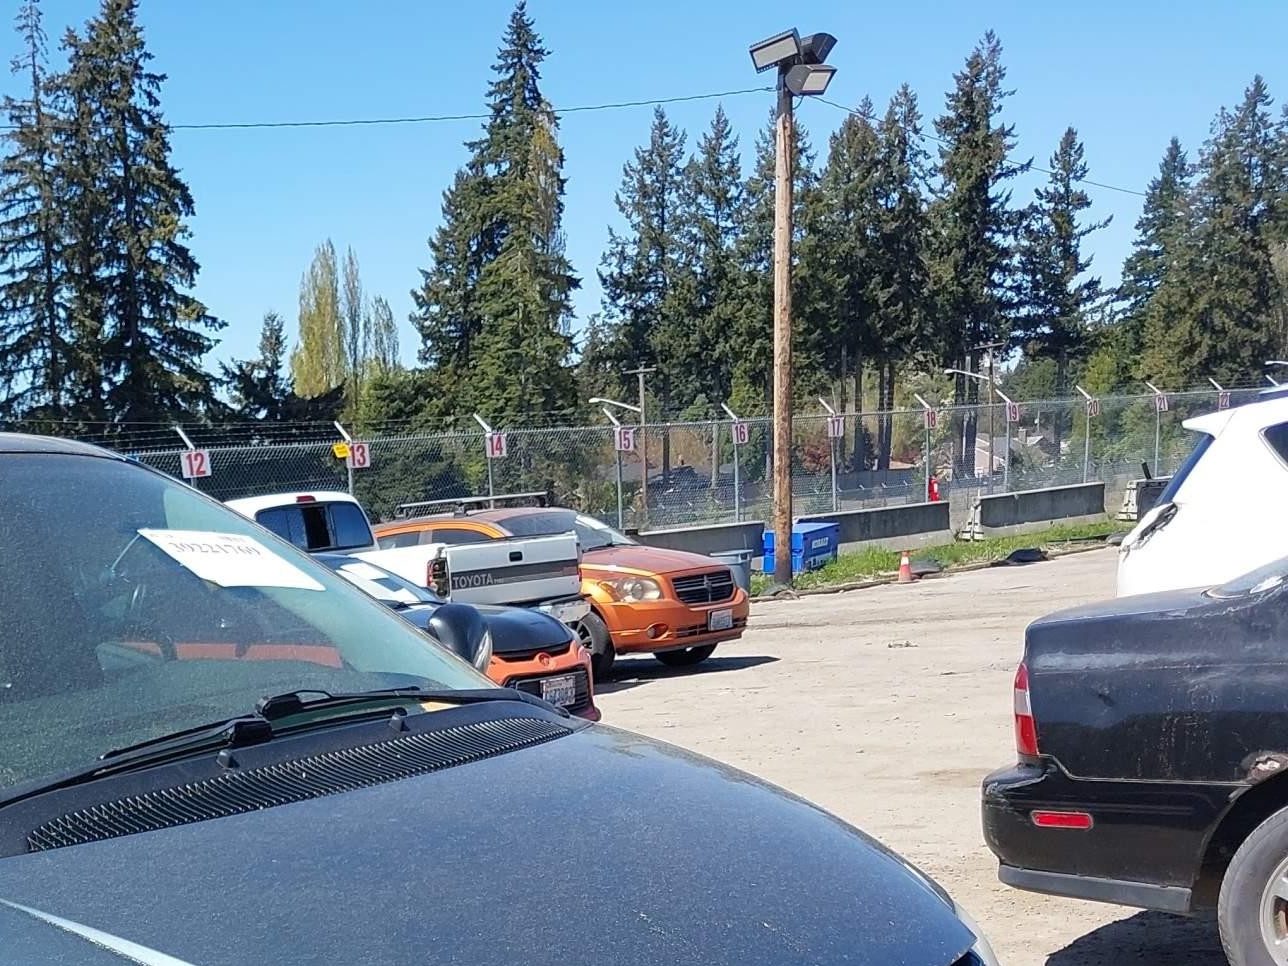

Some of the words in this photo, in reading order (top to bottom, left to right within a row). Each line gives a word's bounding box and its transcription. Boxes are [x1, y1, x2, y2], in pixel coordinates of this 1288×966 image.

[1007, 403, 1018, 421] 19
[1088, 400, 1098, 416] 20
[1158, 396, 1168, 411] 21
[831, 418, 841, 436] 17
[926, 411, 936, 428] 18
[618, 430, 631, 450] 15
[735, 425, 747, 443] 16
[489, 436, 503, 456] 14
[185, 452, 206, 476] 12
[350, 444, 367, 467] 13
[452, 573, 494, 589] TOYOTA
